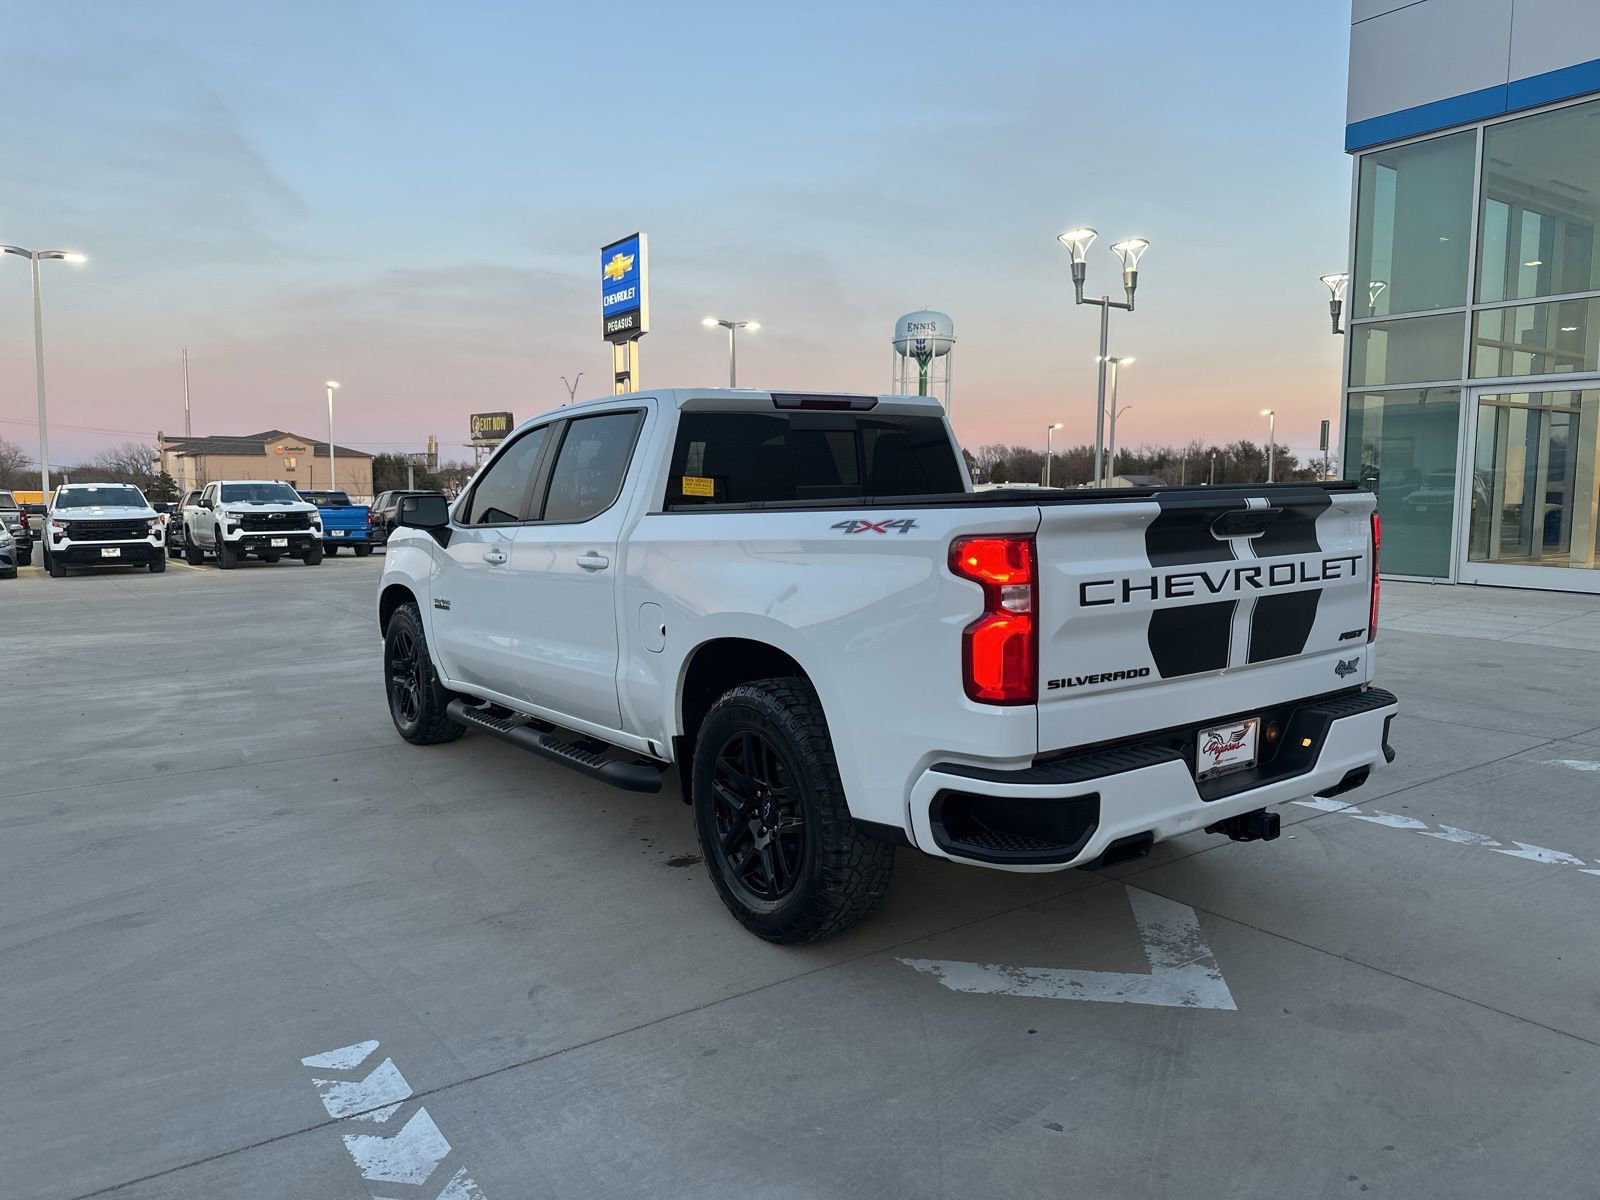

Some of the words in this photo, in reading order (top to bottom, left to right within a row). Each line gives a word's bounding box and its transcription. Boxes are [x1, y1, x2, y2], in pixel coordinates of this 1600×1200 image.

[604, 287, 636, 307] CHEVROLET
[607, 316, 633, 332] PEGASUS
[907, 321, 936, 332] ENNIS
[480, 417, 492, 431] EXIT
[492, 416, 506, 431] NOW
[1079, 555, 1363, 607] CHEVROLET
[1047, 667, 1150, 690] SILVERADO
